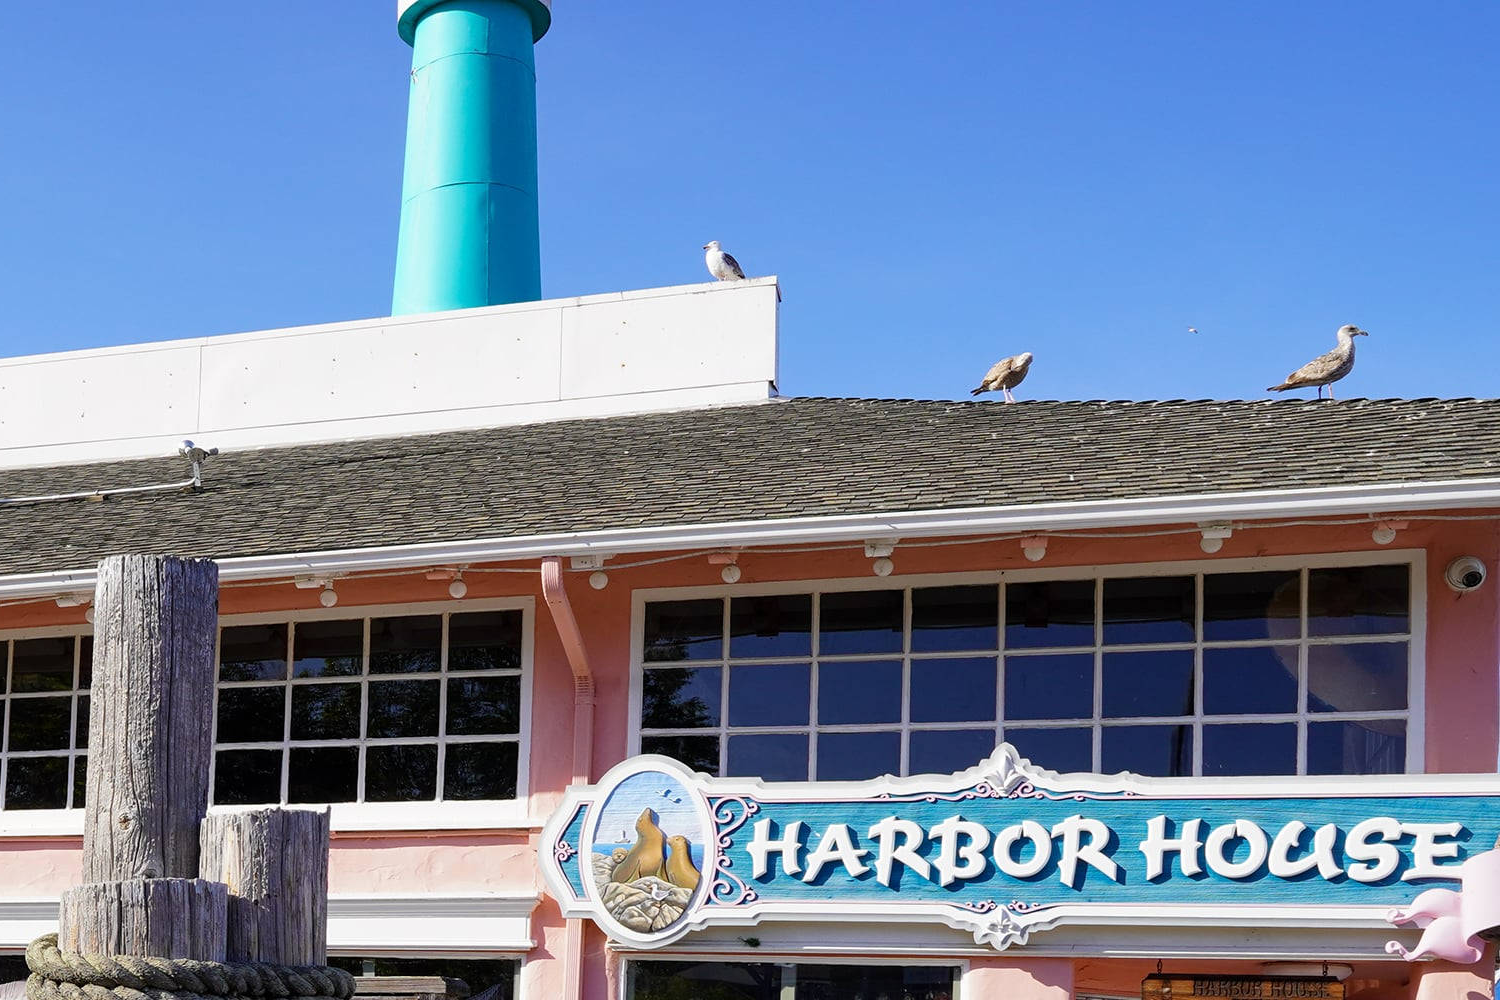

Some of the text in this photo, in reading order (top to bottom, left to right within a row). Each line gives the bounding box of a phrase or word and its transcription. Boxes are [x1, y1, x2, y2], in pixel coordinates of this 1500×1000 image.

[747, 812, 1467, 890] HARBOR HOUSE
[1193, 979, 1331, 999] HARBOR HOUSE
